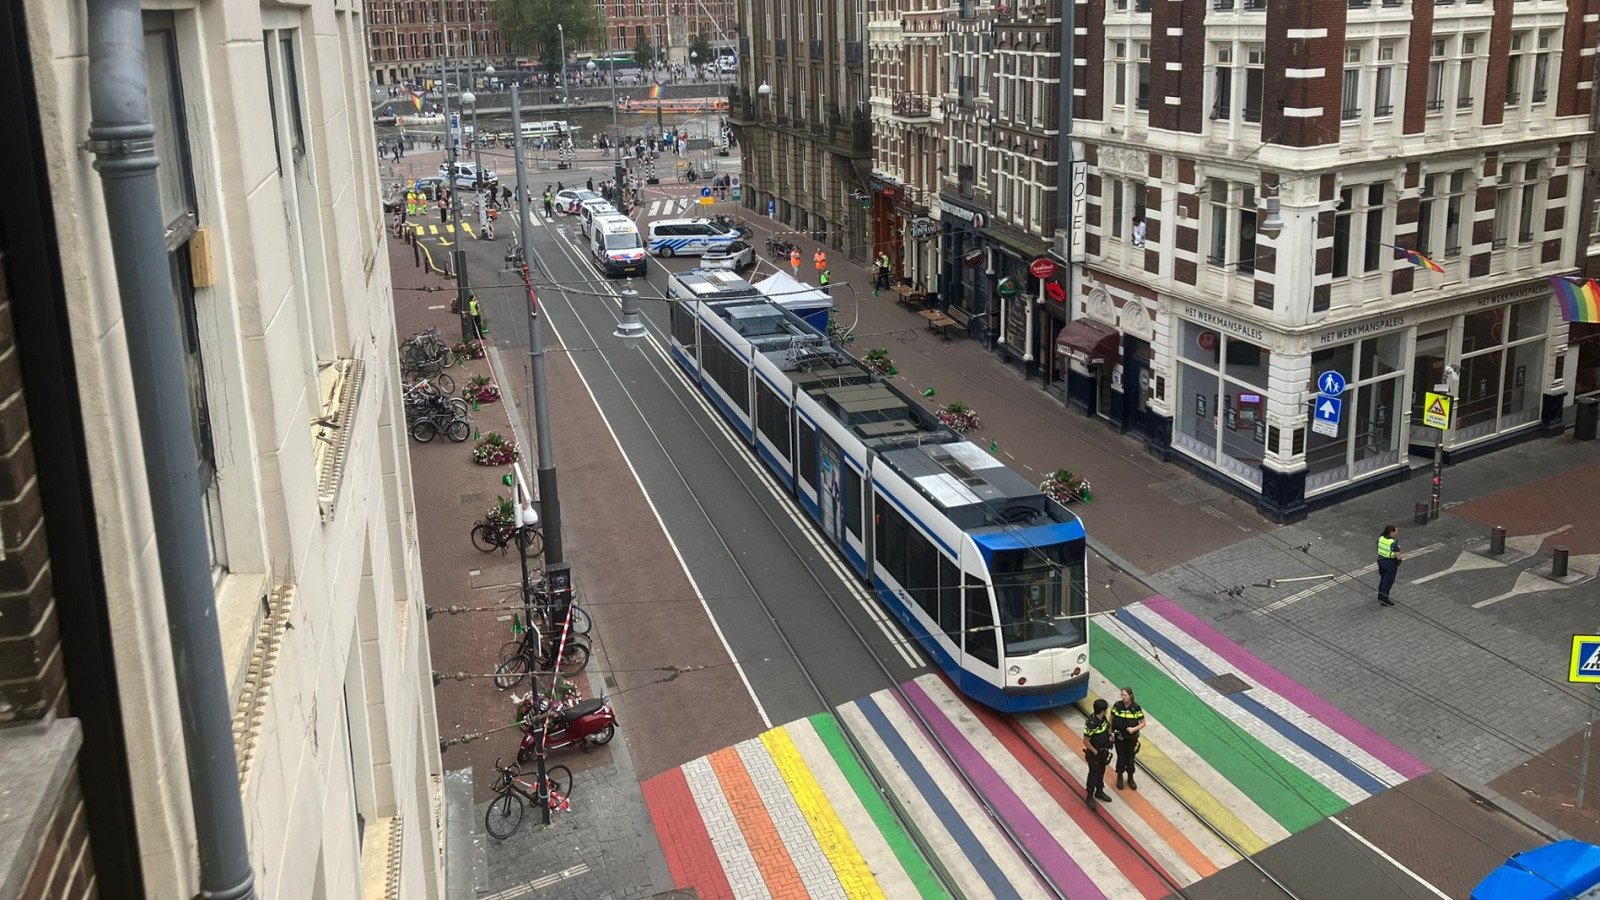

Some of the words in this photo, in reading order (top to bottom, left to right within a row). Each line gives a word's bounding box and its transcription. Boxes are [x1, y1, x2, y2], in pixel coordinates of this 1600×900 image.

[1073, 166, 1086, 246] HOTEL
[1477, 296, 1491, 307] HET
[1491, 285, 1549, 304] WERKMANSPALEIS
[1184, 306, 1197, 318] HET
[1198, 311, 1263, 340] WERKMANSPALEIS
[1320, 331, 1335, 343] HET
[1336, 315, 1405, 339] WERKMANSPALEIS
